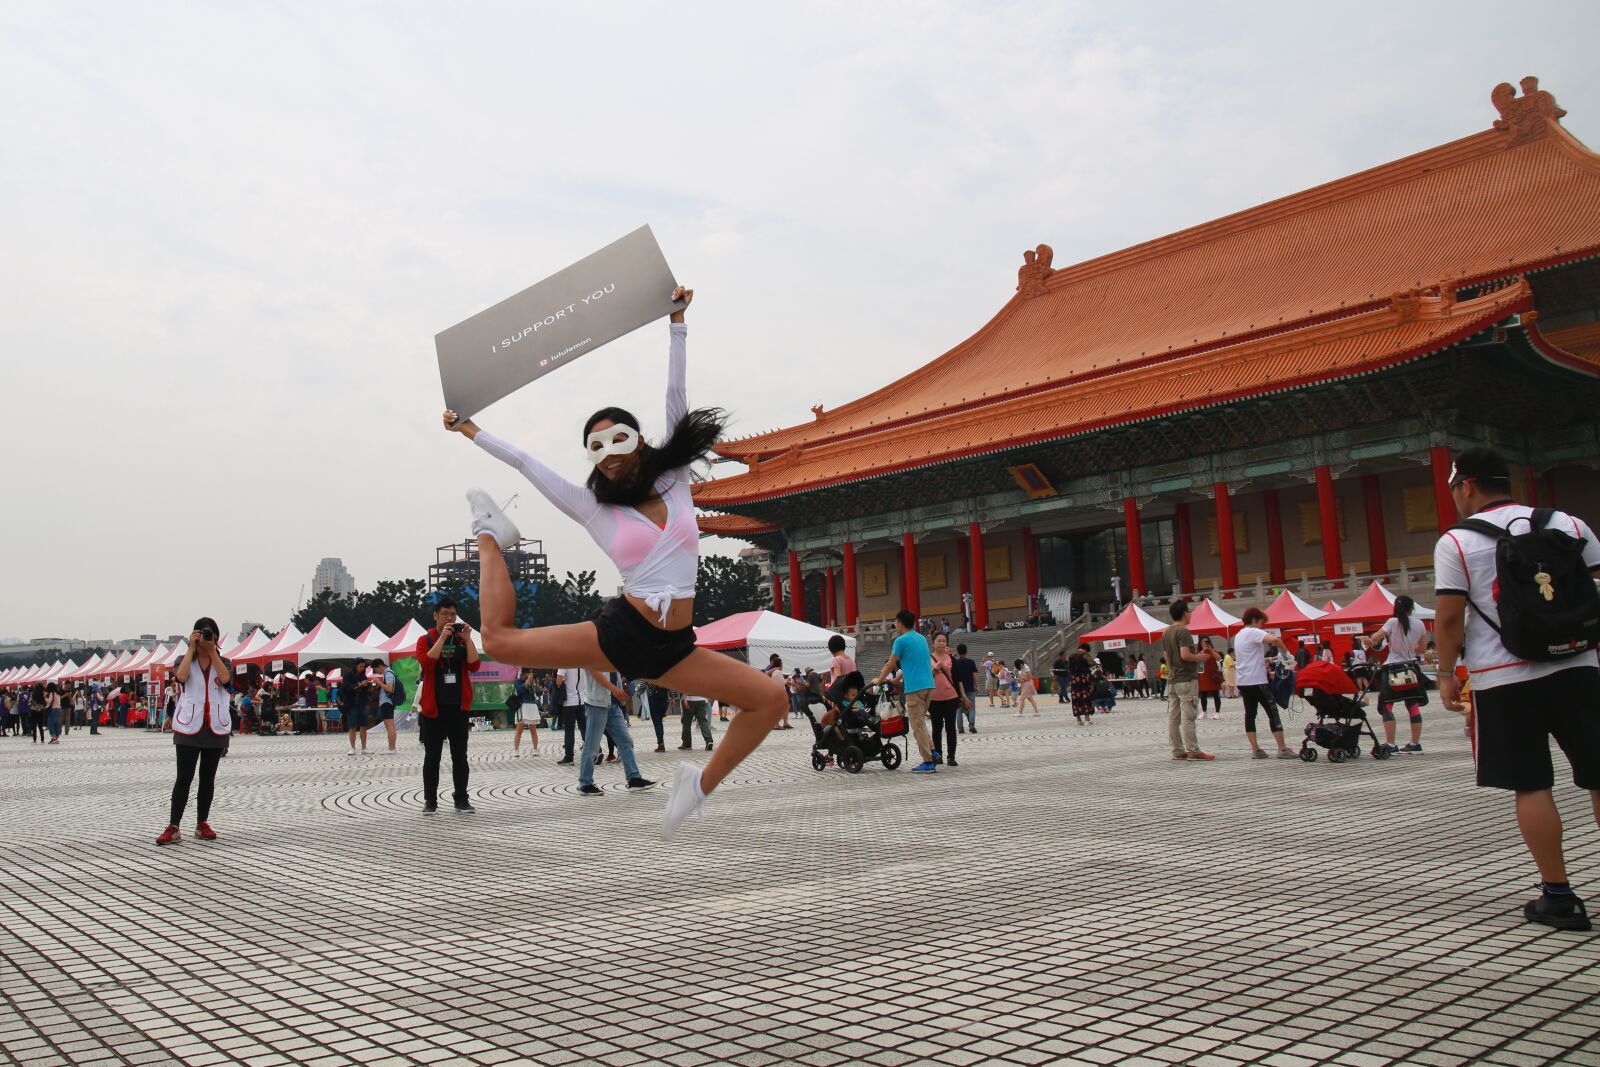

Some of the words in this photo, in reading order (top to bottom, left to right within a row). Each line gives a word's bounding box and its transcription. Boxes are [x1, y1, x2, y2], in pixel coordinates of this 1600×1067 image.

[501, 303, 576, 348] SUPPORT
[580, 283, 615, 305] YOU
[550, 337, 591, 361] lululemon
